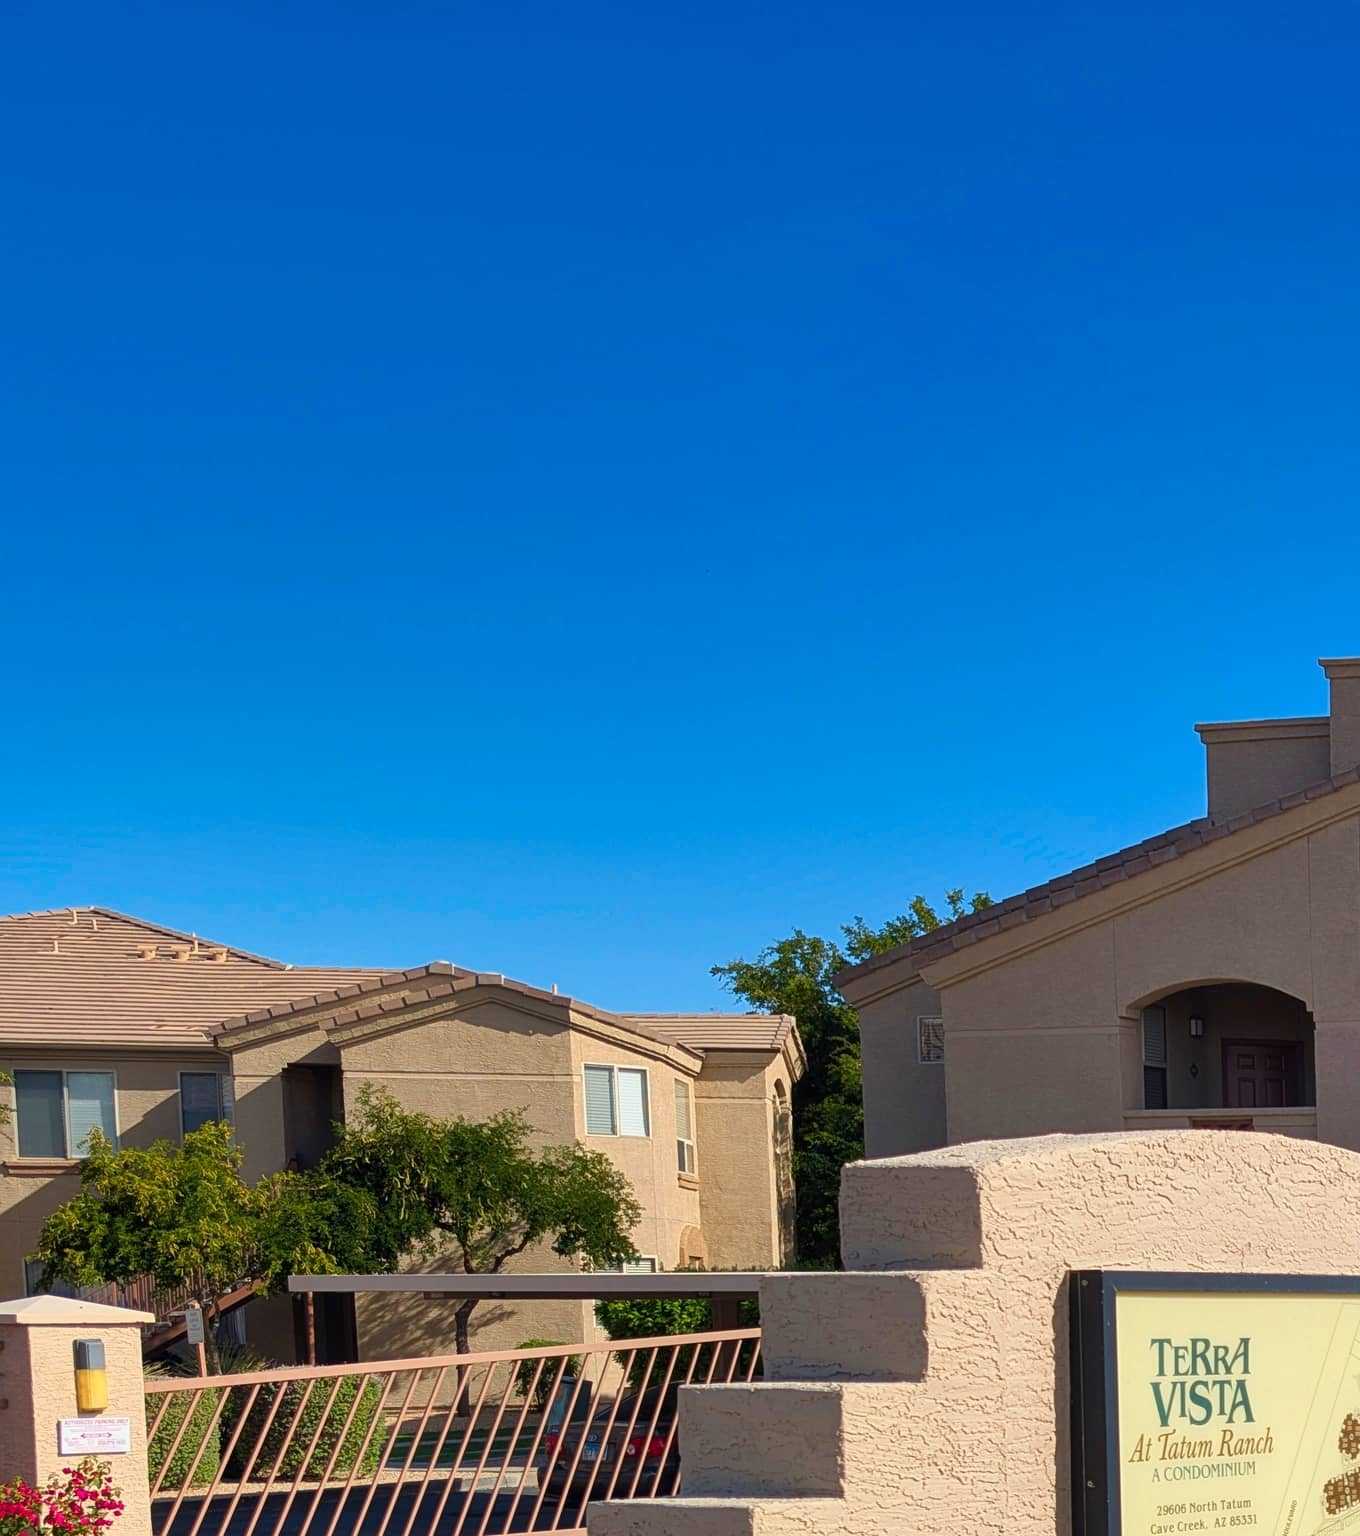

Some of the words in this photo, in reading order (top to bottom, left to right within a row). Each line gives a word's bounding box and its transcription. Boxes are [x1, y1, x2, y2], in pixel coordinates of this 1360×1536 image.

[1149, 1337, 1251, 1377] TERRA
[1149, 1379, 1256, 1428] VISTA
[1128, 1434, 1152, 1463] At
[1157, 1428, 1213, 1461] Tatum
[1217, 1427, 1274, 1457] Ranch
[1152, 1467, 1160, 1483] A
[1163, 1460, 1256, 1482] CONDOMINIUM
[1156, 1504, 1187, 1517] 29606
[1189, 1501, 1218, 1514] North
[1221, 1498, 1252, 1511] Tatum
[1150, 1521, 1175, 1536] Cave
[1214, 1516, 1227, 1529] AZ
[1229, 1513, 1258, 1527] 85331
